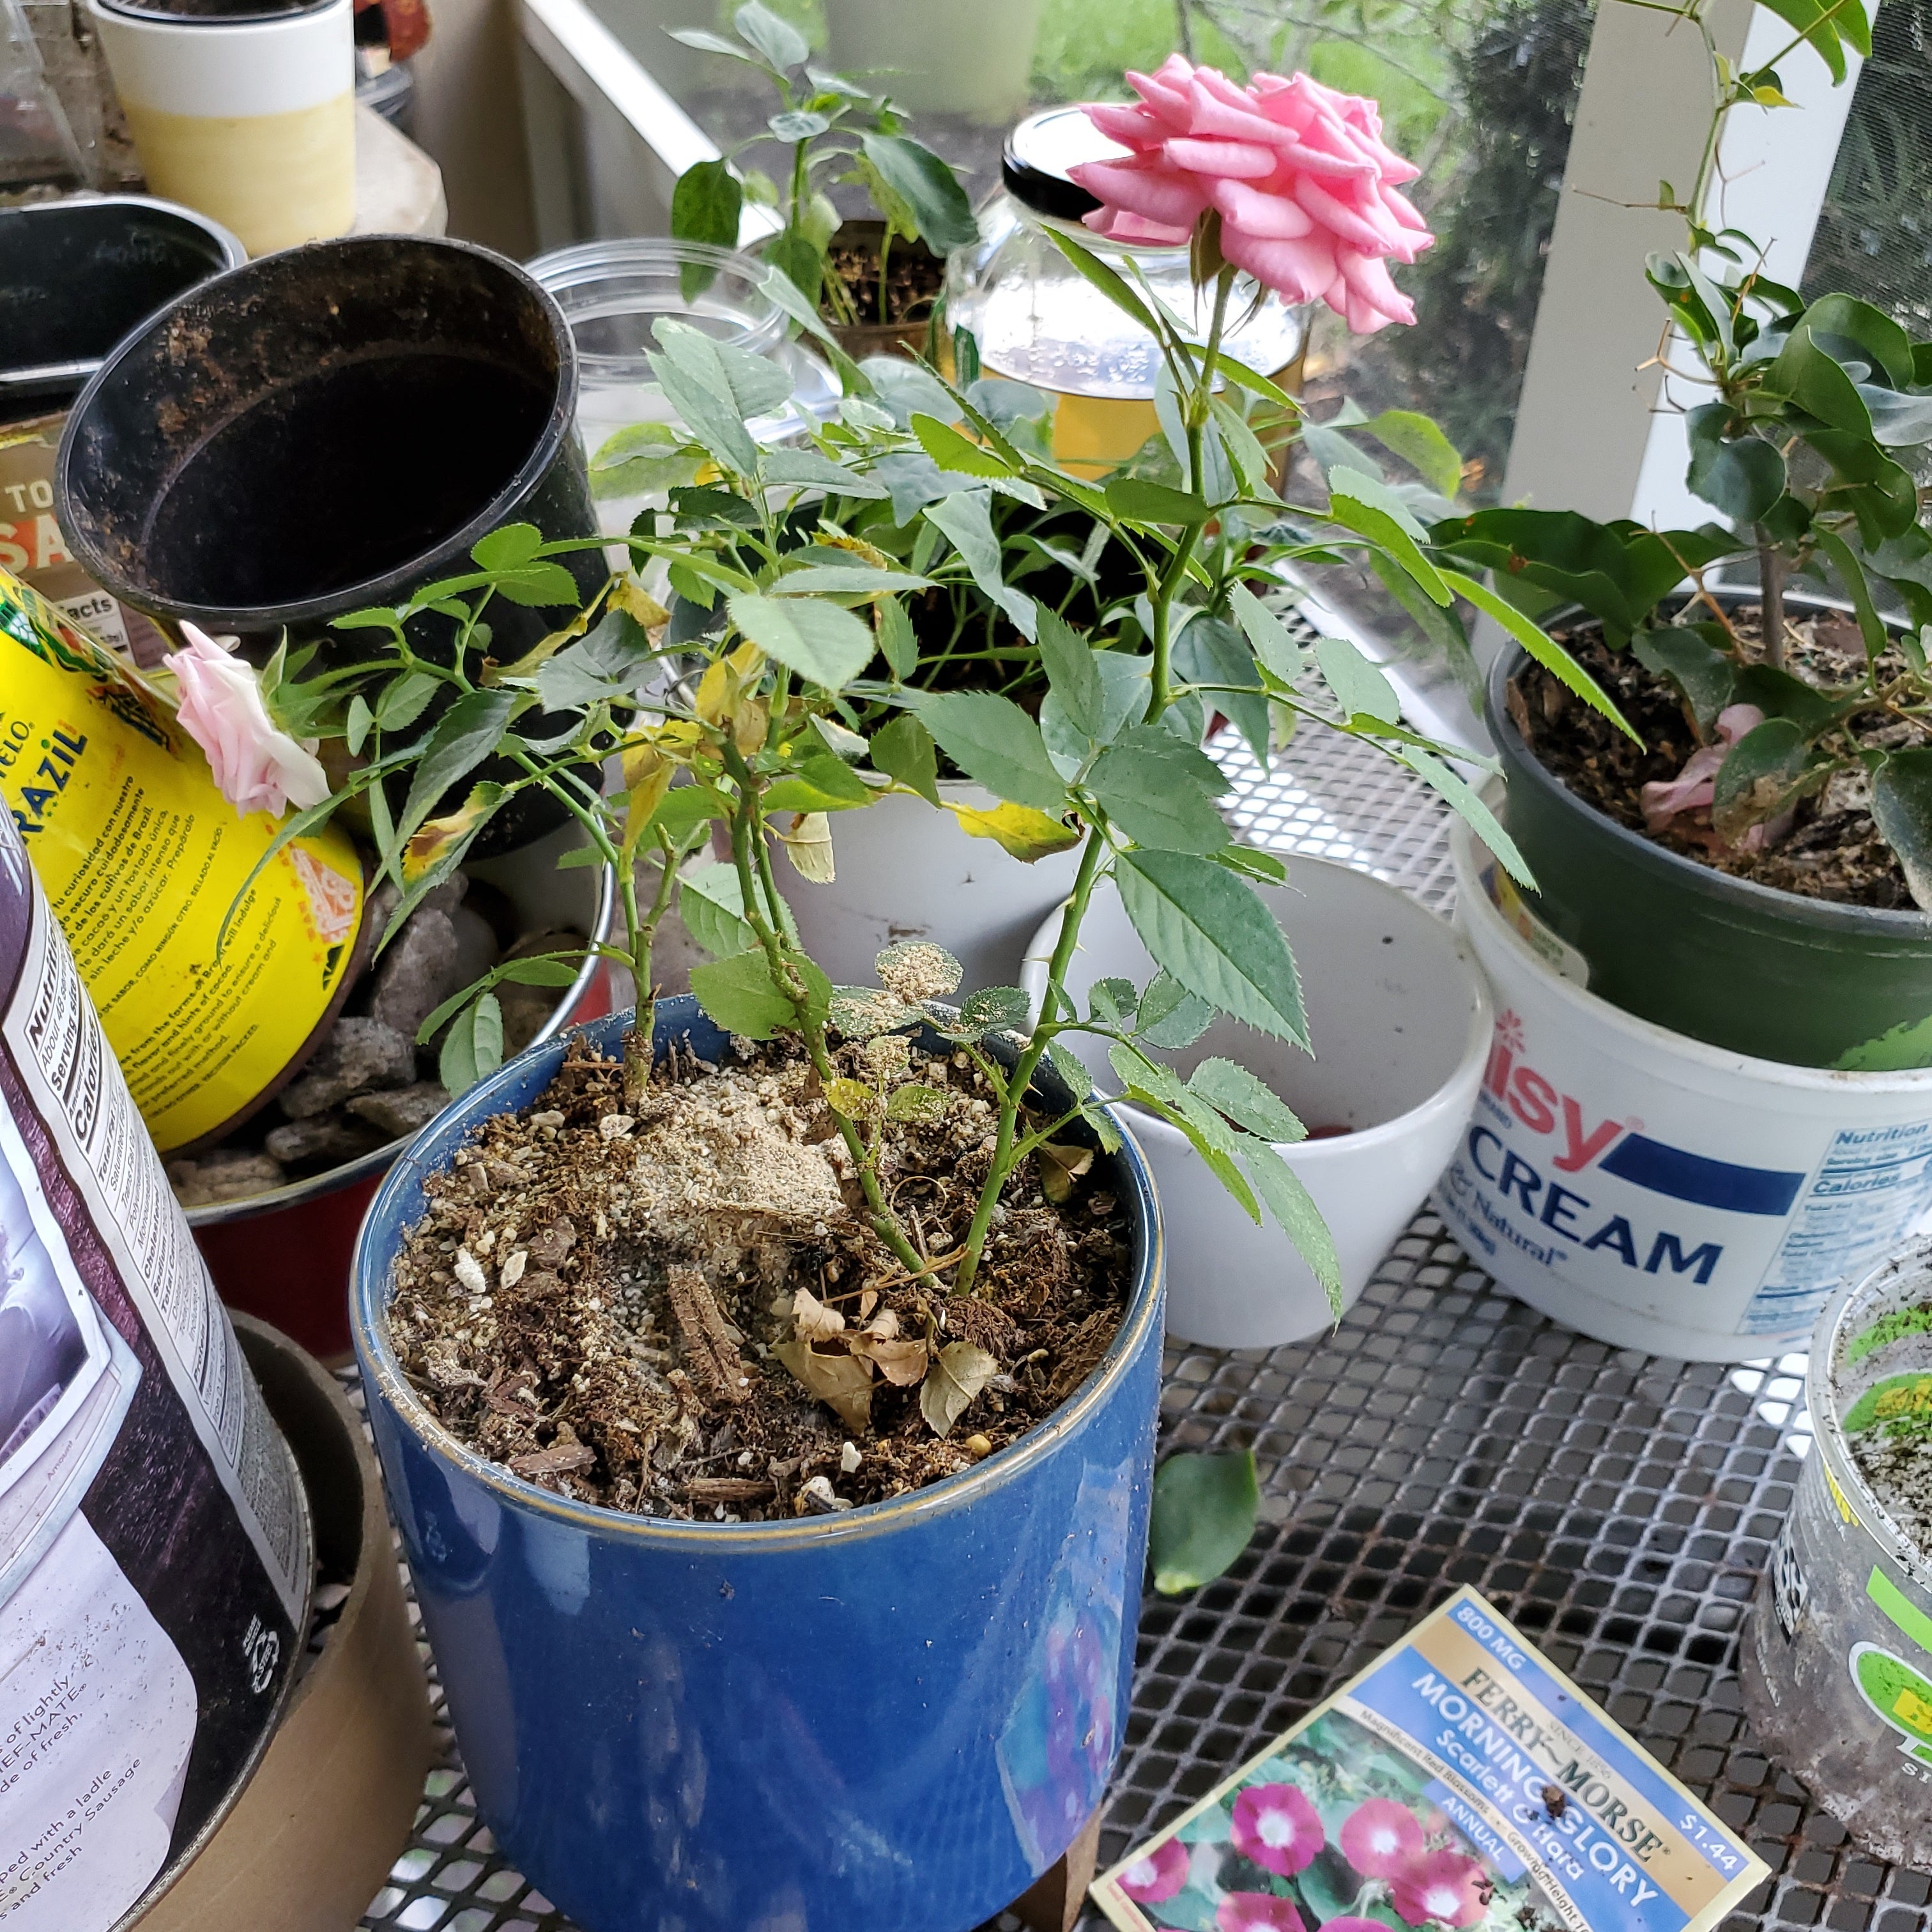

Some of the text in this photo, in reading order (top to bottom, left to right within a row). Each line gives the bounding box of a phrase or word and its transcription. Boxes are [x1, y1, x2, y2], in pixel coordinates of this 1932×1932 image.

[60, 597, 113, 620] acts
[0, 721, 30, 779] ELO
[64, 838, 105, 897] curiosidad
[103, 818, 116, 838] con
[112, 776, 134, 816] nuestro
[75, 918, 88, 931] de
[84, 900, 101, 917] los
[126, 841, 138, 858] de
[132, 806, 155, 841] Brazil.
[70, 878, 98, 914] oscuro
[114, 914, 127, 930] un
[126, 879, 149, 913] sabor
[168, 813, 181, 838] que
[82, 913, 110, 947] cacao
[108, 902, 118, 914] y
[114, 888, 128, 904] un
[102, 936, 130, 965] leche
[41, 1018, 61, 1074] About
[56, 995, 65, 1022] 48
[51, 1015, 77, 1091] Serving
[75, 1015, 98, 1141] Calories
[1483, 1009, 1624, 1174] isy
[98, 1137, 112, 1183] Total
[1835, 1124, 1929, 1145] Nutrition
[1468, 1126, 1724, 1285] CREAM
[1813, 1172, 1901, 1193] Calories
[1457, 1606, 1527, 1670] 800 MG
[6, 1675, 69, 1745] of lightly
[23, 1749, 38, 1771] of
[40, 1712, 83, 1752] fresh,
[1436, 1728, 1515, 1804] Scarlett
[19, 1822, 83, 1882] Country
[84, 1758, 141, 1821] Sausage
[30, 1820, 65, 1851] with
[66, 1809, 77, 1820] a
[75, 1770, 112, 1807] ladle
[1441, 1796, 1506, 1862] ANNUAL
[1678, 1813, 1739, 1872] $1.44
[11, 1846, 82, 1911] and fresh
